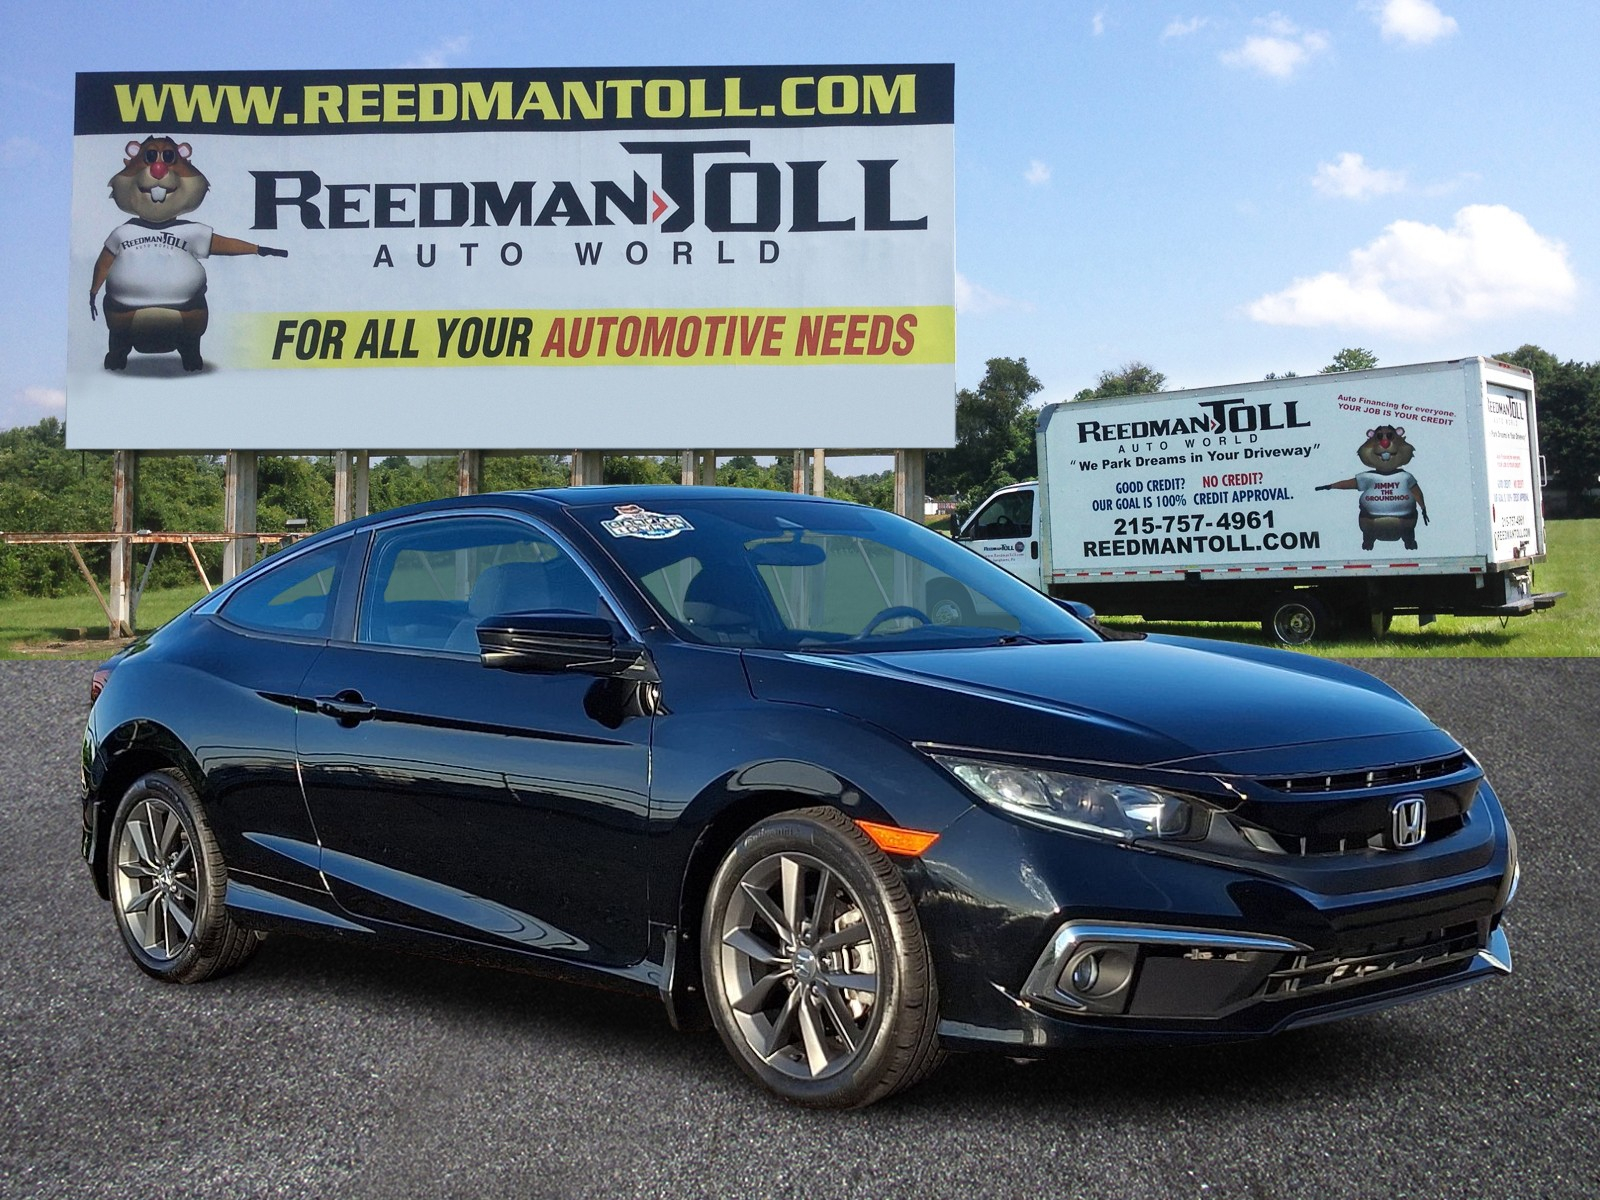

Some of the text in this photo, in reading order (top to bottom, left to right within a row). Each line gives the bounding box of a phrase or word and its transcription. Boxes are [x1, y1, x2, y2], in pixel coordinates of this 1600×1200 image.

[114, 74, 917, 125] WWW.REEDMANTOLL.COM
[372, 240, 780, 269] AUTO WORLD
[272, 313, 918, 360] FOR ALL YOUR AUTOMOTIVE NEEDS
[1337, 394, 1457, 418] Auto Financing for everyone.
[1338, 403, 1361, 412] YOUR
[1363, 407, 1381, 415] JOB
[1394, 411, 1418, 421] YOUR
[1420, 415, 1454, 426] CREDIT
[1118, 434, 1259, 454] AUTO WORLD
[1102, 457, 1132, 470] Park
[1135, 453, 1187, 467] Dreams
[1190, 451, 1203, 463] in
[1207, 450, 1239, 462] Your
[1115, 472, 1263, 494] GOOD CREDIT? NO CREDIT?
[1374, 481, 1400, 490] JIMMY
[1092, 487, 1294, 511] OUR GOAL IS 100% CREDIT APPROVAL.
[1365, 494, 1409, 502] GROUNDHOG
[1113, 510, 1275, 535] 215-757-4961
[1083, 531, 1320, 557] REEDMANTOLL.COM
